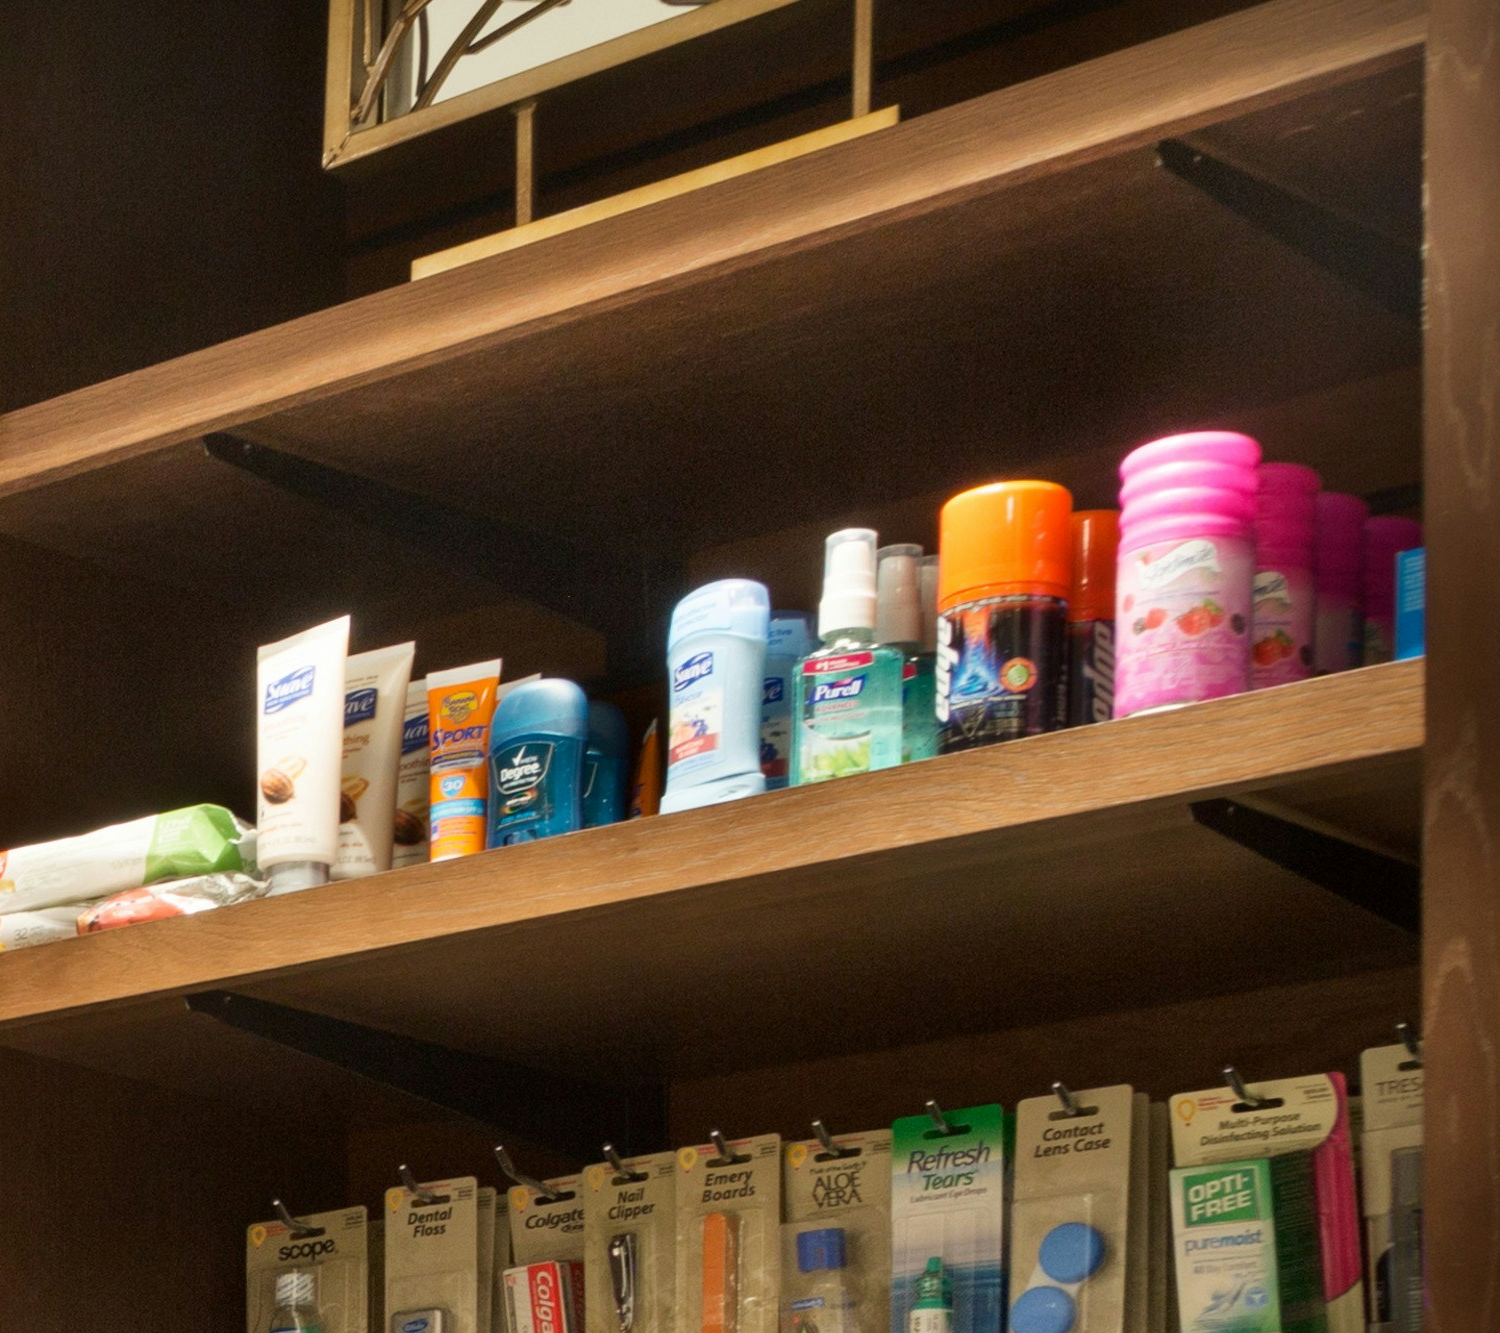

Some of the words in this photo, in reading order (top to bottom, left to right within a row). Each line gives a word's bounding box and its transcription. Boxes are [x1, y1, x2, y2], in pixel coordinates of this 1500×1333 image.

[266, 667, 316, 702] Suave
[813, 679, 864, 701] Purell
[433, 725, 488, 752] SPORT
[441, 779, 464, 795] 30
[1041, 1121, 1105, 1142] Contact
[1217, 1111, 1300, 1131] Multi-Purpose
[1200, 1127, 1270, 1147] Disinfecting
[1270, 1121, 1321, 1136] Solution
[907, 1141, 990, 1174] Refresh
[1033, 1138, 1068, 1158] Lens
[1072, 1137, 1111, 1154] Case
[704, 1169, 754, 1191] Emery
[814, 1169, 861, 1190] ALOE
[922, 1172, 976, 1192] Tears
[1188, 1173, 1251, 1203] OPTI-
[616, 1187, 645, 1204] Nail
[701, 1184, 756, 1202] Boards
[812, 1187, 863, 1208] VERA
[407, 1207, 453, 1226] Dental
[607, 1201, 656, 1222] Clipper
[1189, 1192, 1253, 1224] FREE
[413, 1221, 447, 1238] Floss
[525, 1207, 584, 1234] Colgate
[278, 1239, 336, 1263] scope
[1185, 1229, 1262, 1254] puremoist
